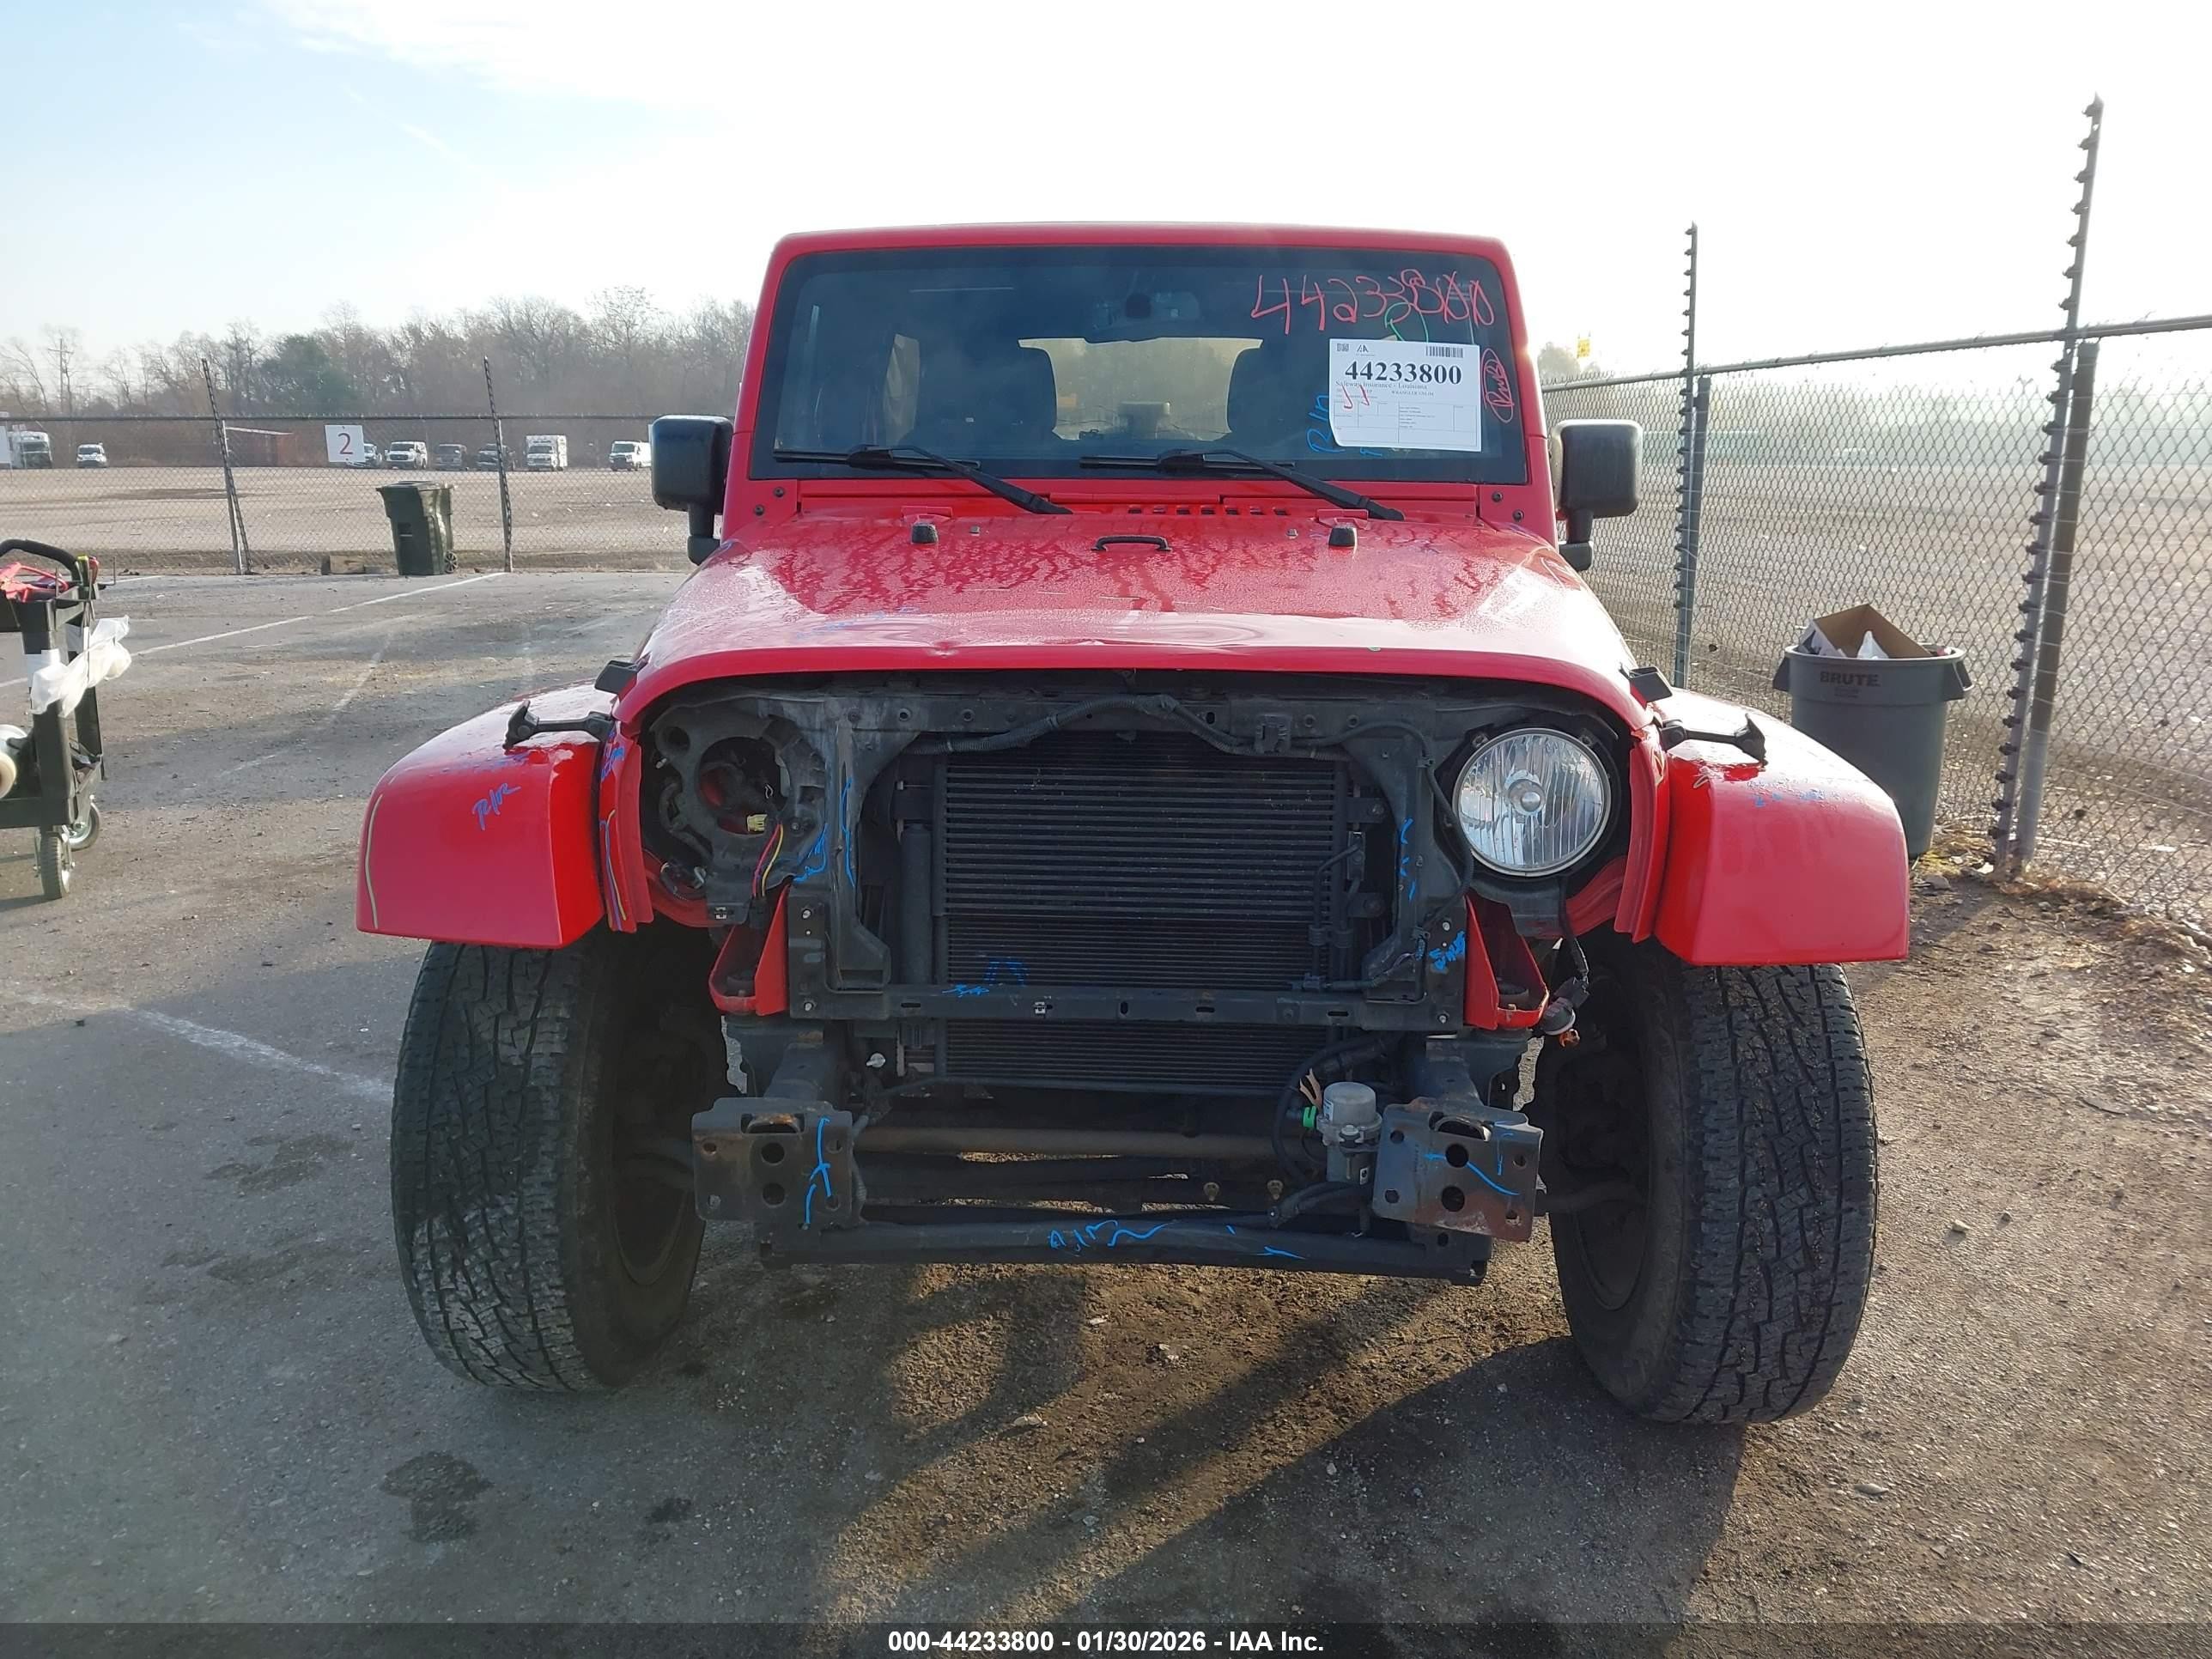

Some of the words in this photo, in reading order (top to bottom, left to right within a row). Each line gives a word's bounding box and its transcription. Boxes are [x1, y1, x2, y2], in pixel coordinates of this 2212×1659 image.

[1345, 361, 1462, 385] 44233800
[337, 433, 353, 454] 2
[1820, 672, 1881, 687] BRUTE
